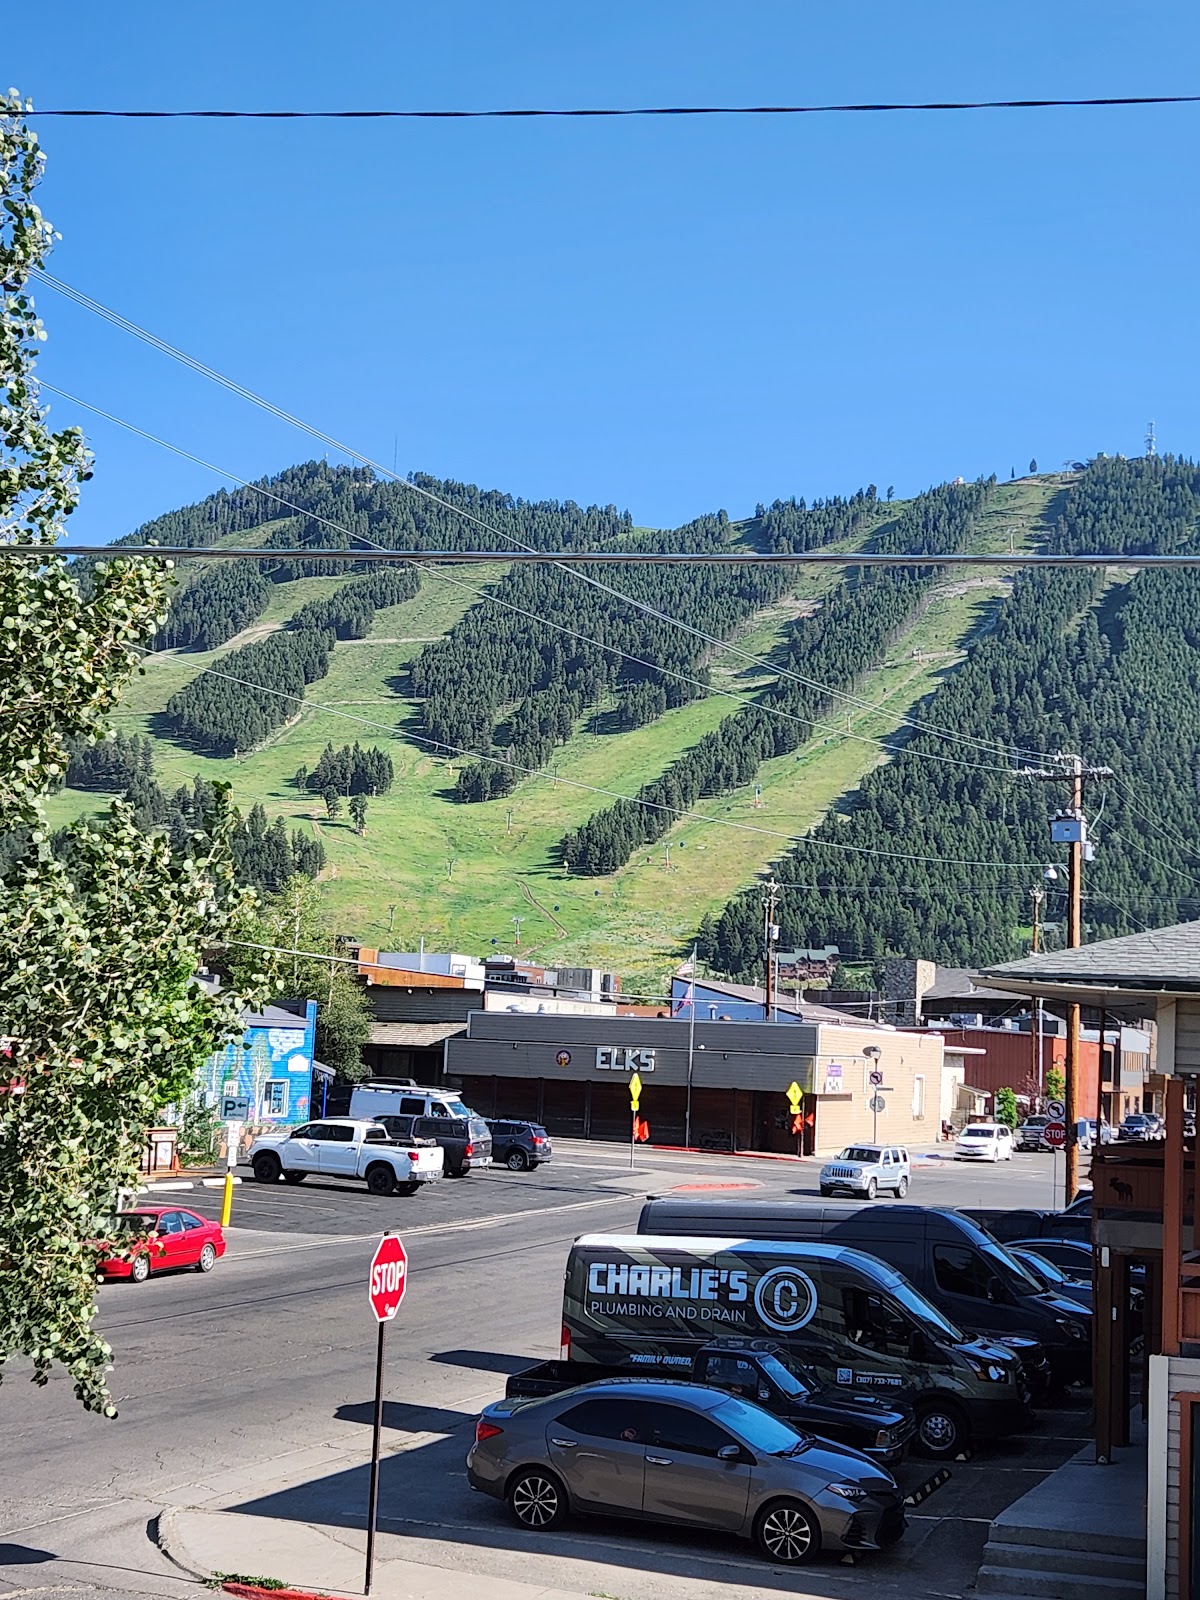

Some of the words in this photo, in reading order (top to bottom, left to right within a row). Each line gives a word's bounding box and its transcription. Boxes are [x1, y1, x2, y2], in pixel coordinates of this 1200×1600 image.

[596, 1047, 655, 1072] ELKS
[1045, 1128, 1066, 1139] STOP
[372, 1260, 404, 1296] STOP
[588, 1262, 748, 1302] CHARLIE'S
[591, 1301, 663, 1318] PLUMBING
[665, 1305, 698, 1320] AND
[701, 1307, 746, 1323] DRAIN
